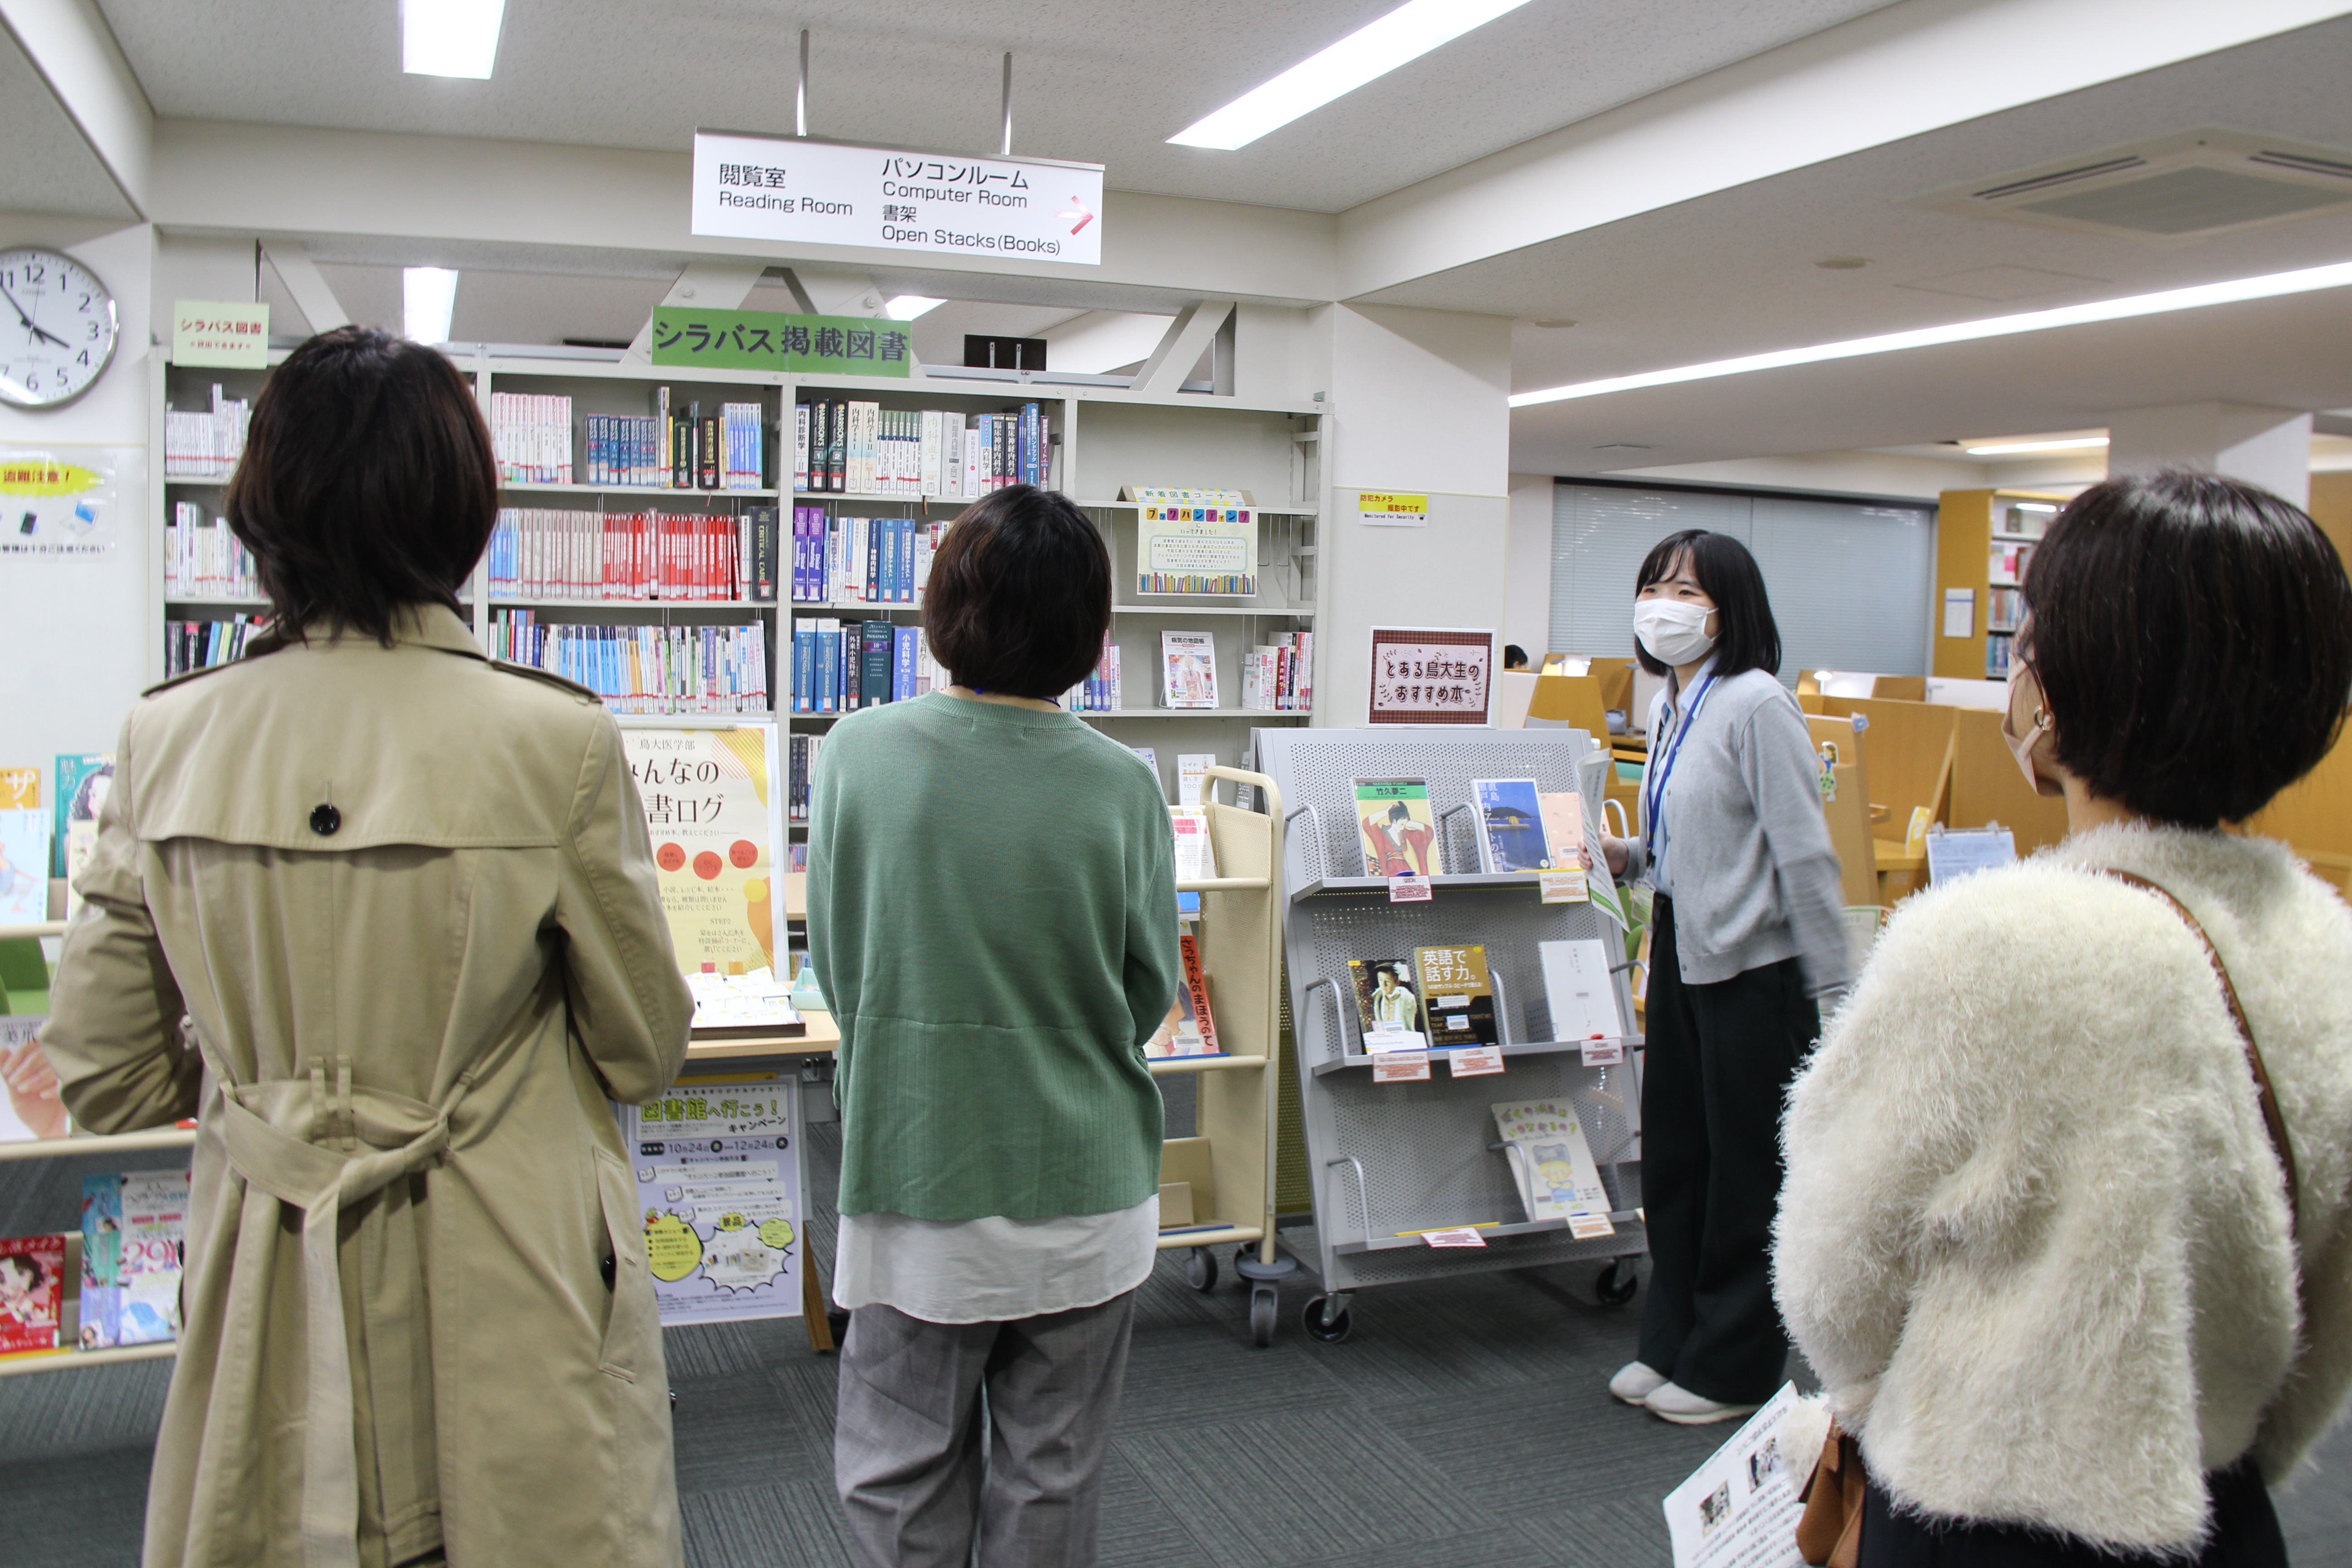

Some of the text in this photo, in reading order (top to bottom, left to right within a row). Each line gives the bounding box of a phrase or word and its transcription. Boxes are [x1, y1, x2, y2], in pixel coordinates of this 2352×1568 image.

[720, 163, 786, 188] 閲覧室
[882, 157, 1029, 190] パソコンルーム
[720, 191, 853, 216] Reading Room
[883, 181, 1028, 208] Computer Room
[882, 204, 917, 223] 書架
[882, 225, 928, 243] Open
[25, 265, 44, 284] 12
[60, 274, 67, 292] 1
[79, 293, 91, 313] 2
[88, 321, 99, 341] 3
[181, 318, 262, 336] シラバス図書
[655, 320, 907, 362] シラバス掲載図書
[77, 349, 90, 367] 4
[26, 373, 39, 392] 6
[57, 368, 68, 387] 5
[1145, 490, 1237, 500] 新着図書コーナー
[1360, 494, 1394, 503] 防犯カメラ
[1148, 508, 1249, 522] ブックハンティング
[1387, 504, 1420, 513] 撮影中です
[902, 633, 911, 667] 小児科学
[1387, 661, 1480, 679] とある鳥大生の
[1395, 685, 1464, 702] おすすめ本
[639, 738, 696, 751] 鳥大医学部
[1376, 787, 1407, 796] 竹久夢二
[1422, 949, 1466, 966] 英語で
[1425, 965, 1476, 982] 話す力。
[641, 1097, 777, 1122] 図書館へ行こう！
[729, 1116, 786, 1133] キャンペーン
